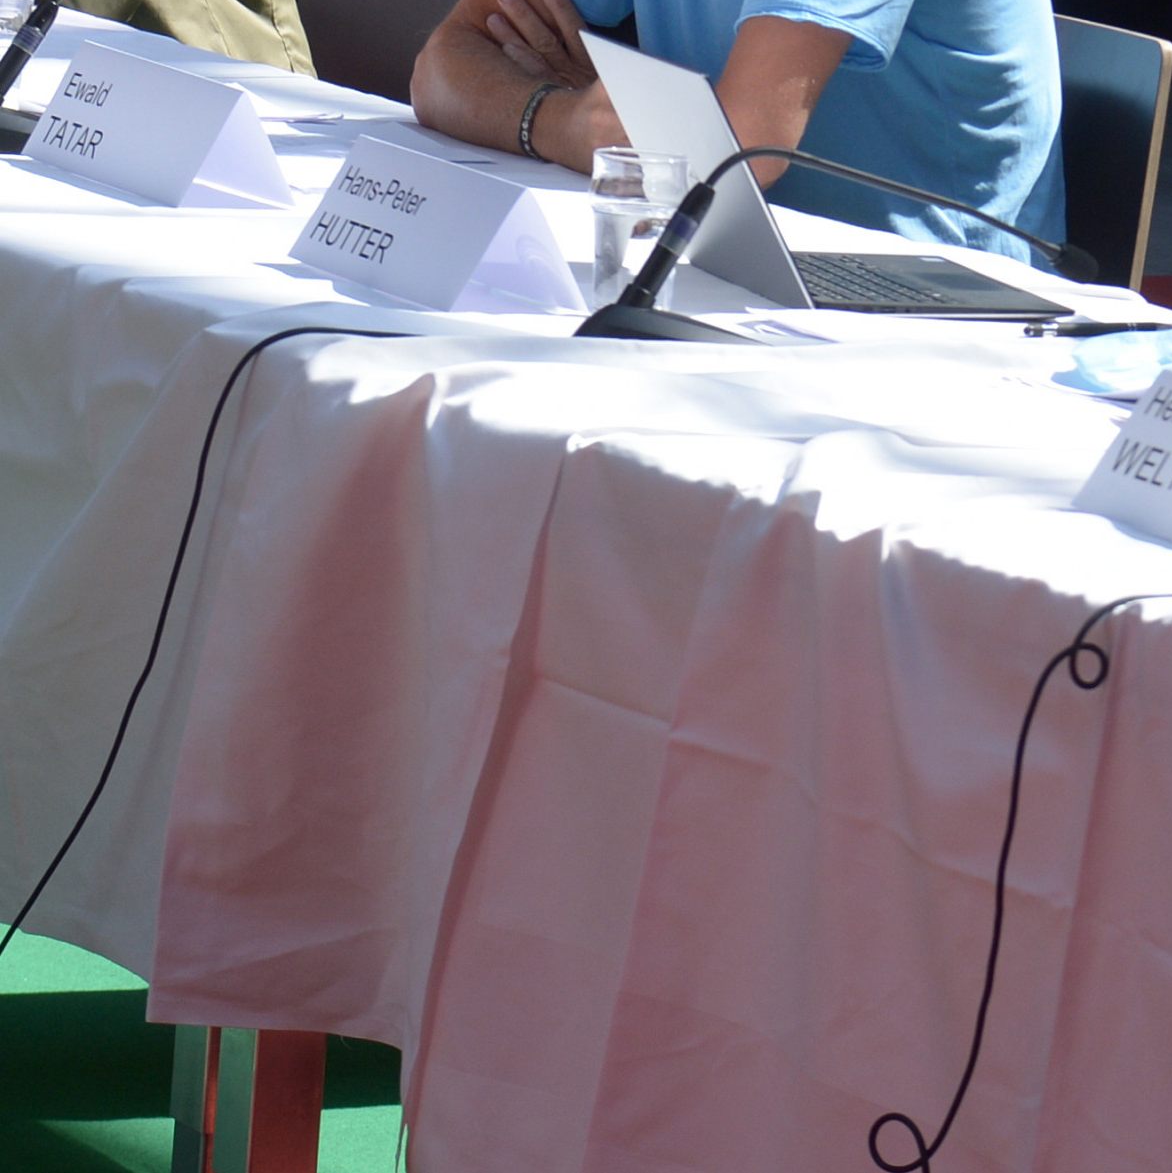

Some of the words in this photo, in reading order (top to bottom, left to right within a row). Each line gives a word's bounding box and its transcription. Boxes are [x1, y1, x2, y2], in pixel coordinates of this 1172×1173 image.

[64, 72, 113, 107] Ewald
[41, 115, 104, 160] TATAR
[338, 165, 426, 216] Hans-Peter
[309, 211, 394, 265] HUTTER
